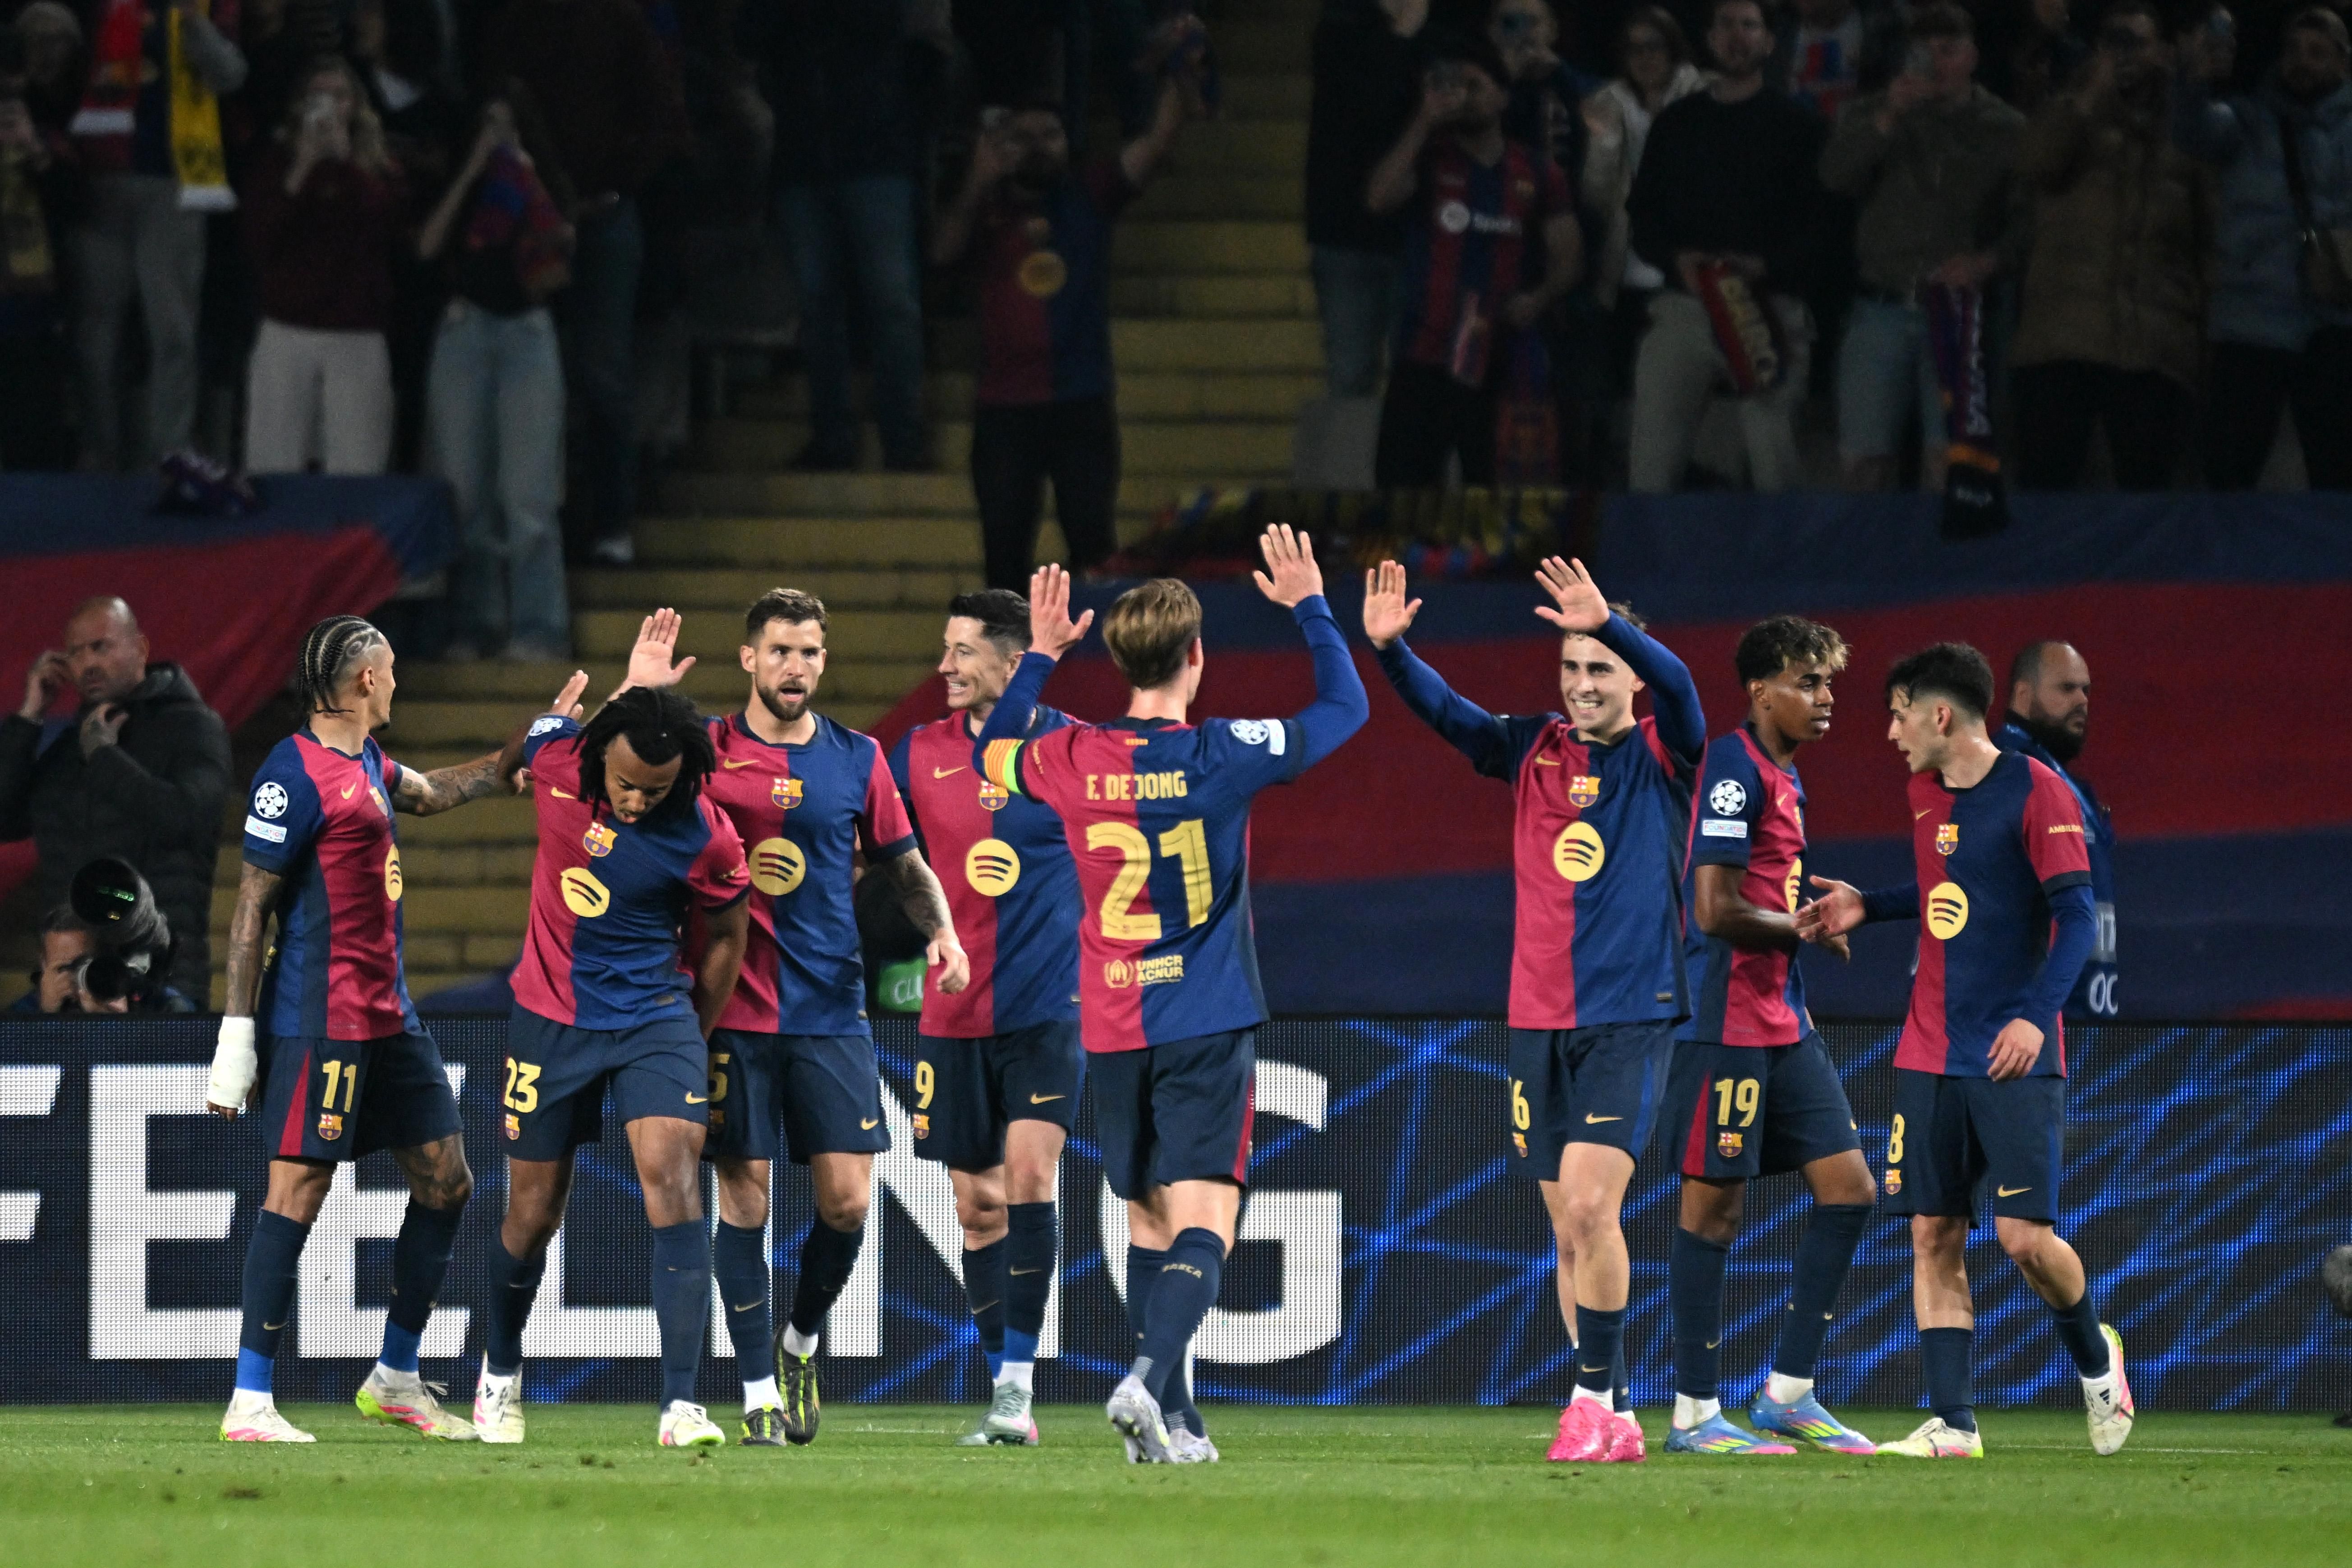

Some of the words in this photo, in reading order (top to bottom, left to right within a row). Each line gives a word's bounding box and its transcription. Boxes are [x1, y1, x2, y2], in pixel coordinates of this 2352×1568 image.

[1087, 774, 1100, 800] F.
[1106, 774, 1131, 800] DE
[1134, 770, 1188, 800] JONG
[1086, 818, 1213, 940] 21
[1136, 955, 1184, 972] UNHCR
[1137, 967, 1185, 982] ACNUR
[322, 1059, 357, 1113] 11
[504, 1056, 542, 1113] 23
[707, 1053, 730, 1102] 5
[915, 1061, 935, 1110] 9
[1508, 1075, 1530, 1130] 6
[1715, 1078, 1760, 1127] 19
[1888, 1113, 1906, 1164] 8
